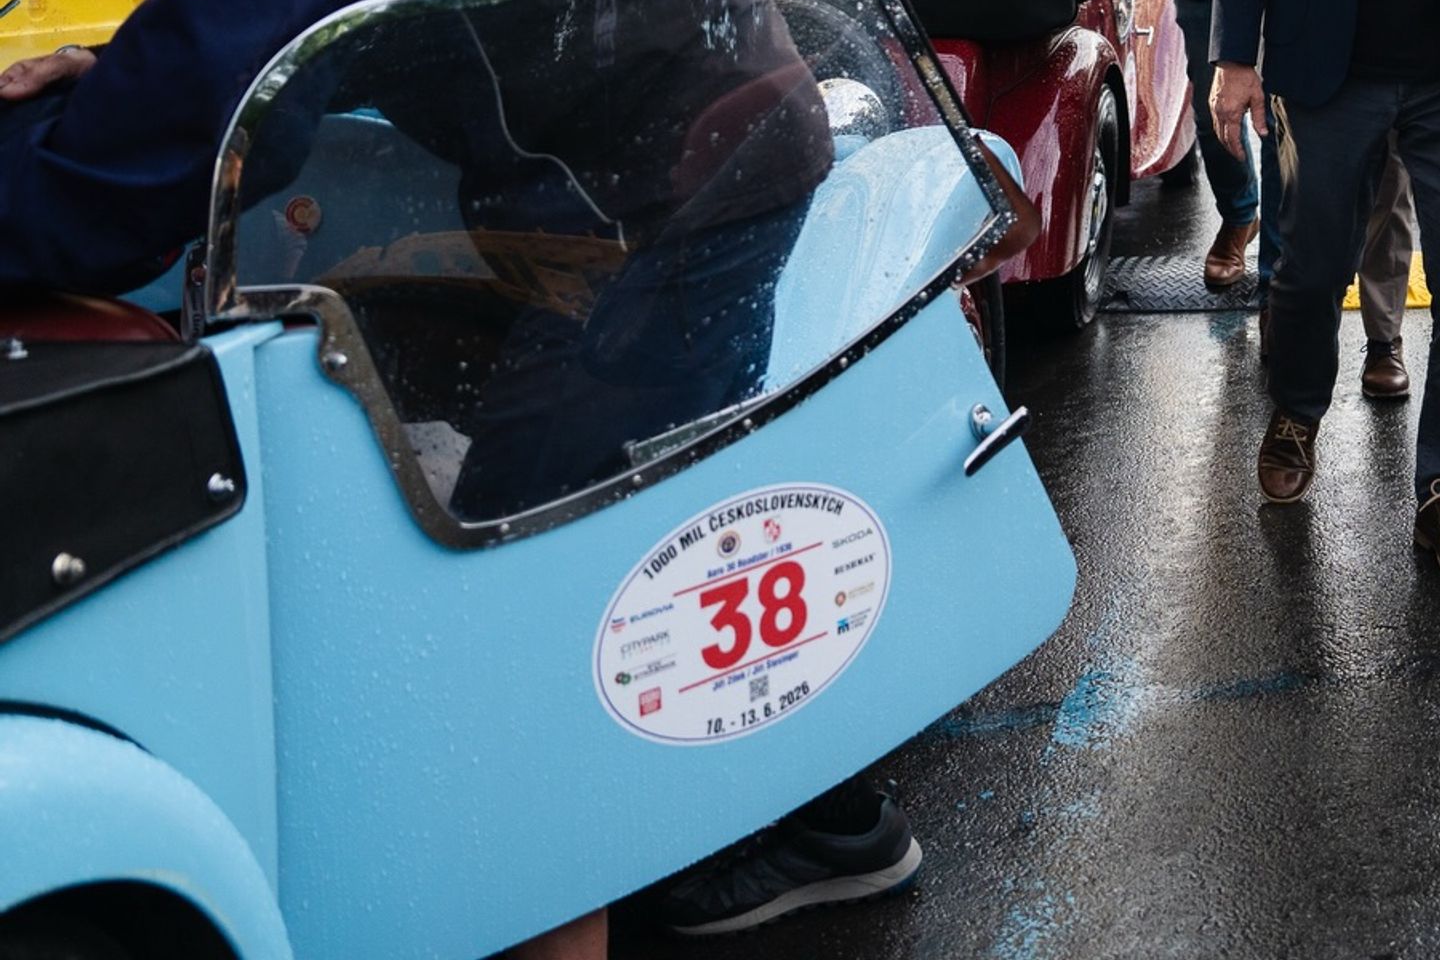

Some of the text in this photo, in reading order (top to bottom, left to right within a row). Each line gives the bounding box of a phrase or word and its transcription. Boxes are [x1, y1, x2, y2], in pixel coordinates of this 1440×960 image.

[643, 492, 845, 580] 1000 MIL ČESKOSLOVENSKÝCH
[699, 560, 807, 670] 38
[707, 718, 726, 735] 10.
[741, 709, 760, 727] 13.
[764, 702, 776, 717] 6.
[779, 681, 810, 710] 2026
